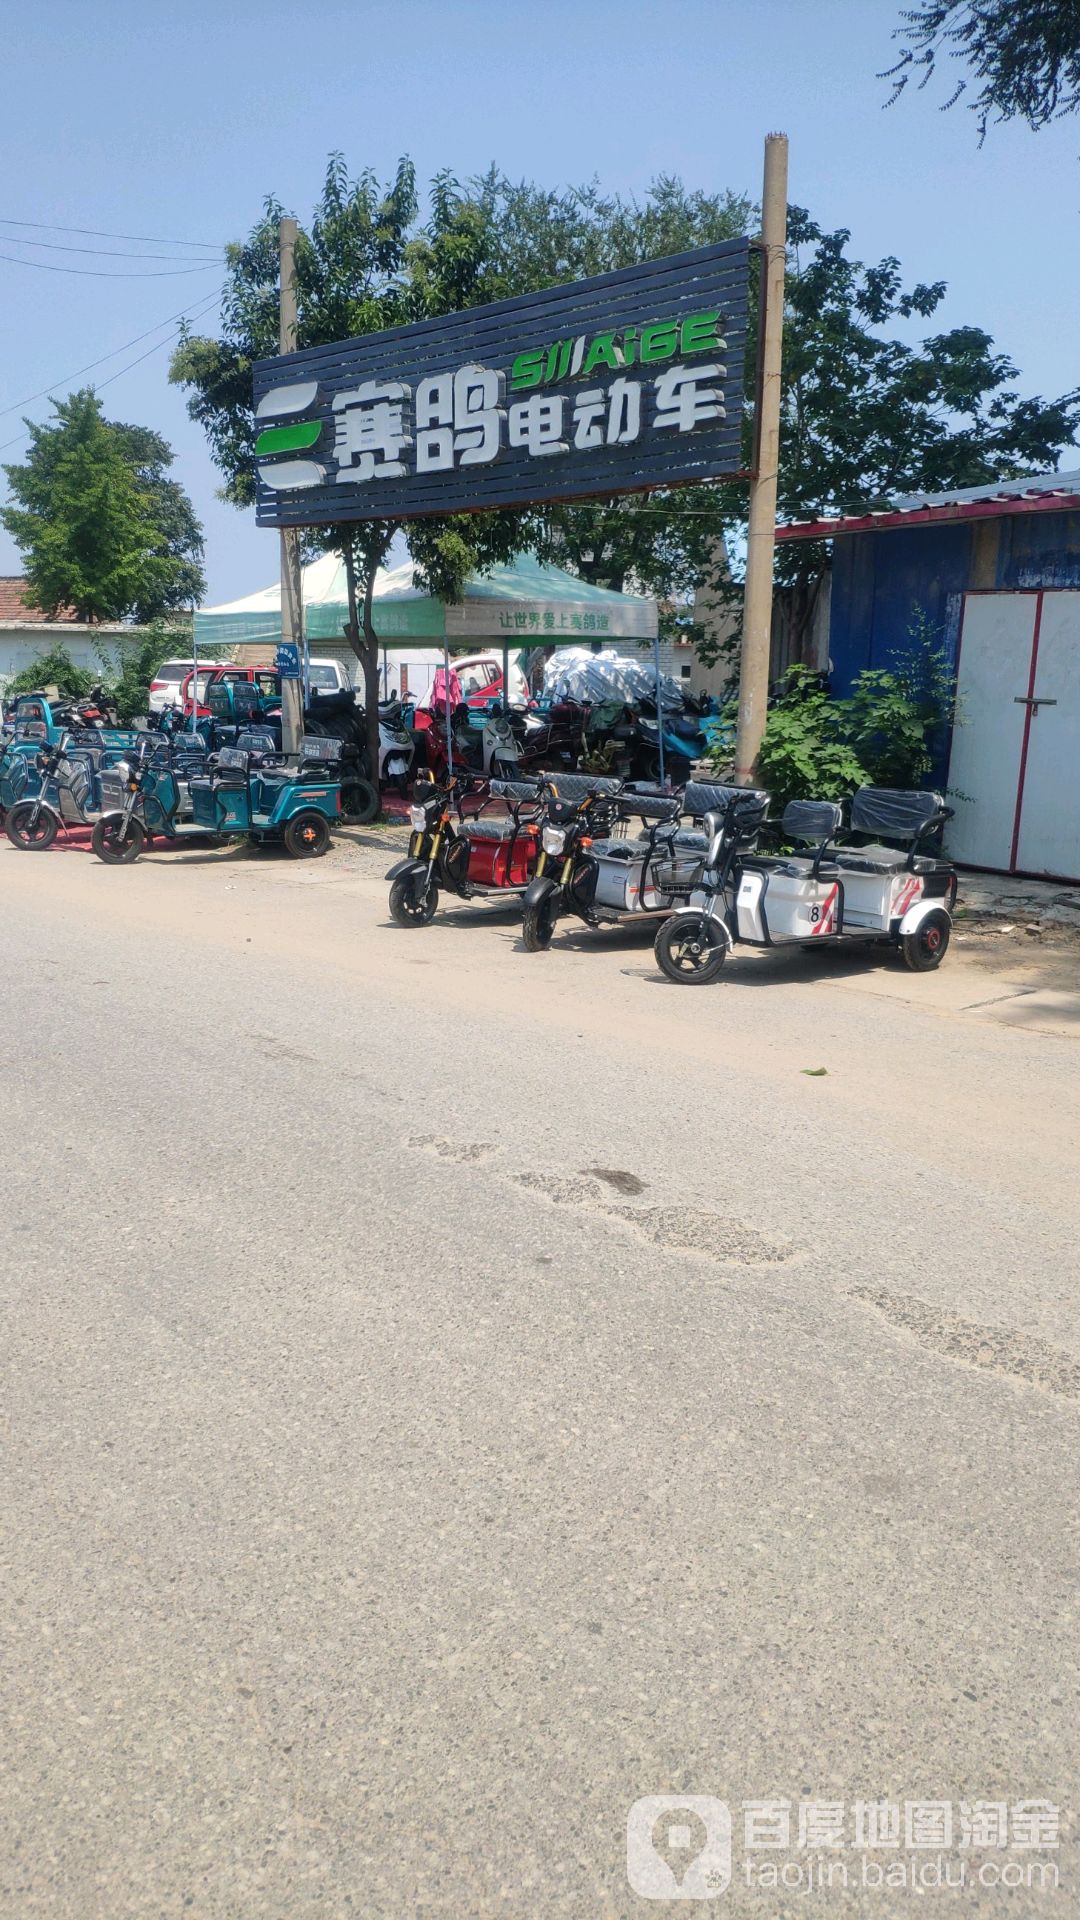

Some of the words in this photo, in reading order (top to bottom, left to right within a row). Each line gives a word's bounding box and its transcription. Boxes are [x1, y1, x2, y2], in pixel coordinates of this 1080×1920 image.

[332, 363, 727, 484] 赛鸽电动车
[499, 611, 609, 631] 让世界爱上赛鸽造
[810, 906, 820, 922] 8
